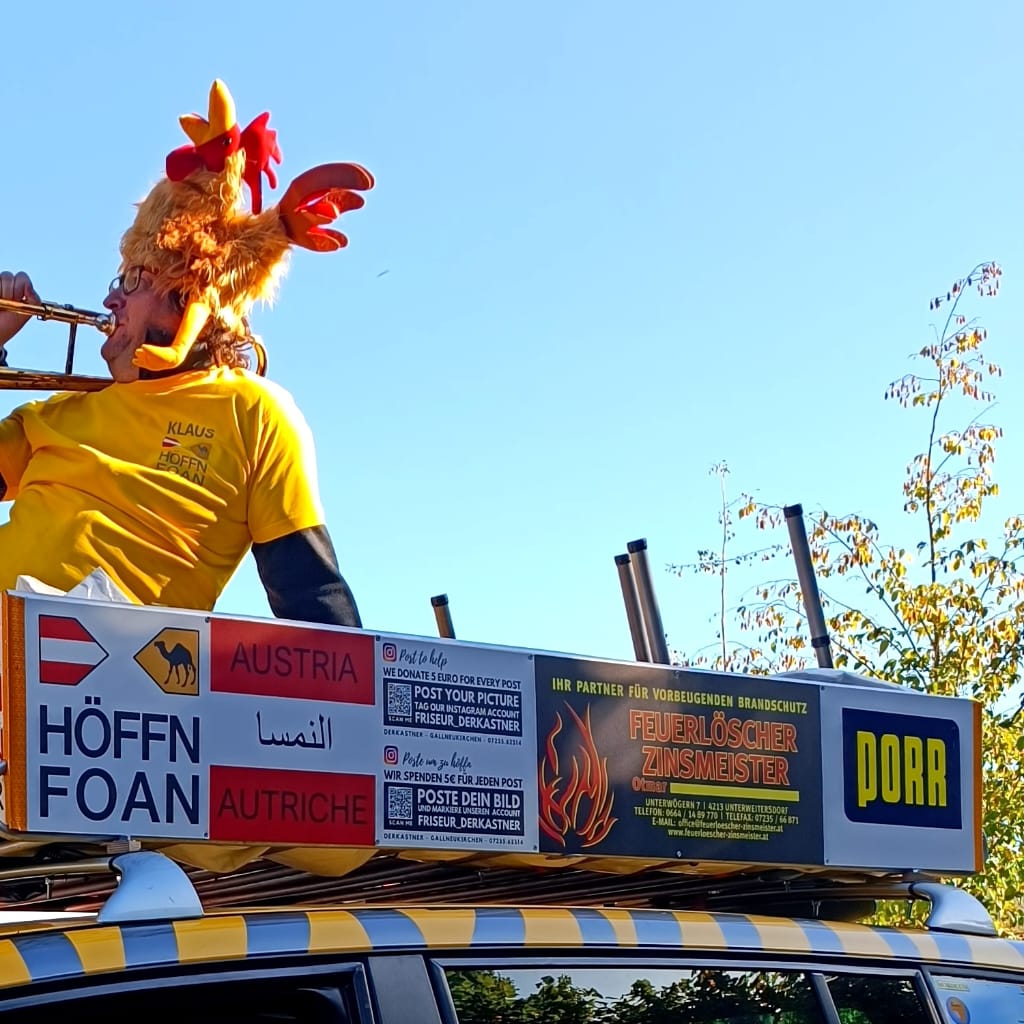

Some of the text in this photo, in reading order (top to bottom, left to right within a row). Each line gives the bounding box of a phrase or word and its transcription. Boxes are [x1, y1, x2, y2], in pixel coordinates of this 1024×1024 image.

[167, 421, 215, 438] KLAUS
[230, 641, 358, 684] AUSTRIA
[399, 648, 448, 671] Post to help
[382, 666, 522, 690] WE DONATE 5 EURO FOR EVERY POST
[414, 685, 520, 708] POST YOUR PICTURE
[552, 677, 808, 715] IHR PARTNER FÜR VORBEUGENDEN BRANDSCHUTZ
[414, 701, 520, 719] TAG OUR INSTAGRAM ACCOUNT
[39, 695, 201, 764] HÖFFN
[257, 710, 333, 751] النمسا
[415, 712, 521, 732] FRISEUR_DERKASTNER
[628, 709, 799, 753] FEUERLÖSCHER
[402, 752, 424, 768] Poste
[641, 745, 791, 786] ZINSMEISTER
[856, 730, 947, 808] PORR
[384, 769, 524, 789] WIR SPENDEN 5€ FÜR JEDEN POST
[631, 776, 668, 794] Otmar
[39, 765, 200, 825] FOAN
[217, 787, 369, 825] AUTRICHE
[417, 788, 520, 810] POSTE DEIN BILD
[418, 804, 521, 818] UND MARKIERE UNSEREN ACCOUNT
[634, 806, 665, 817] TELEFON:
[726, 812, 754, 822] TELEFAX:
[754, 814, 774, 823] 07235
[645, 798, 694, 809] UNTERWÖGERN
[708, 802, 724, 812] 4213
[724, 803, 789, 815] UNTERWEITERSDORF
[418, 814, 521, 831] FRISEUR_DERKASTNER
[652, 816, 676, 826] E-MAIL:
